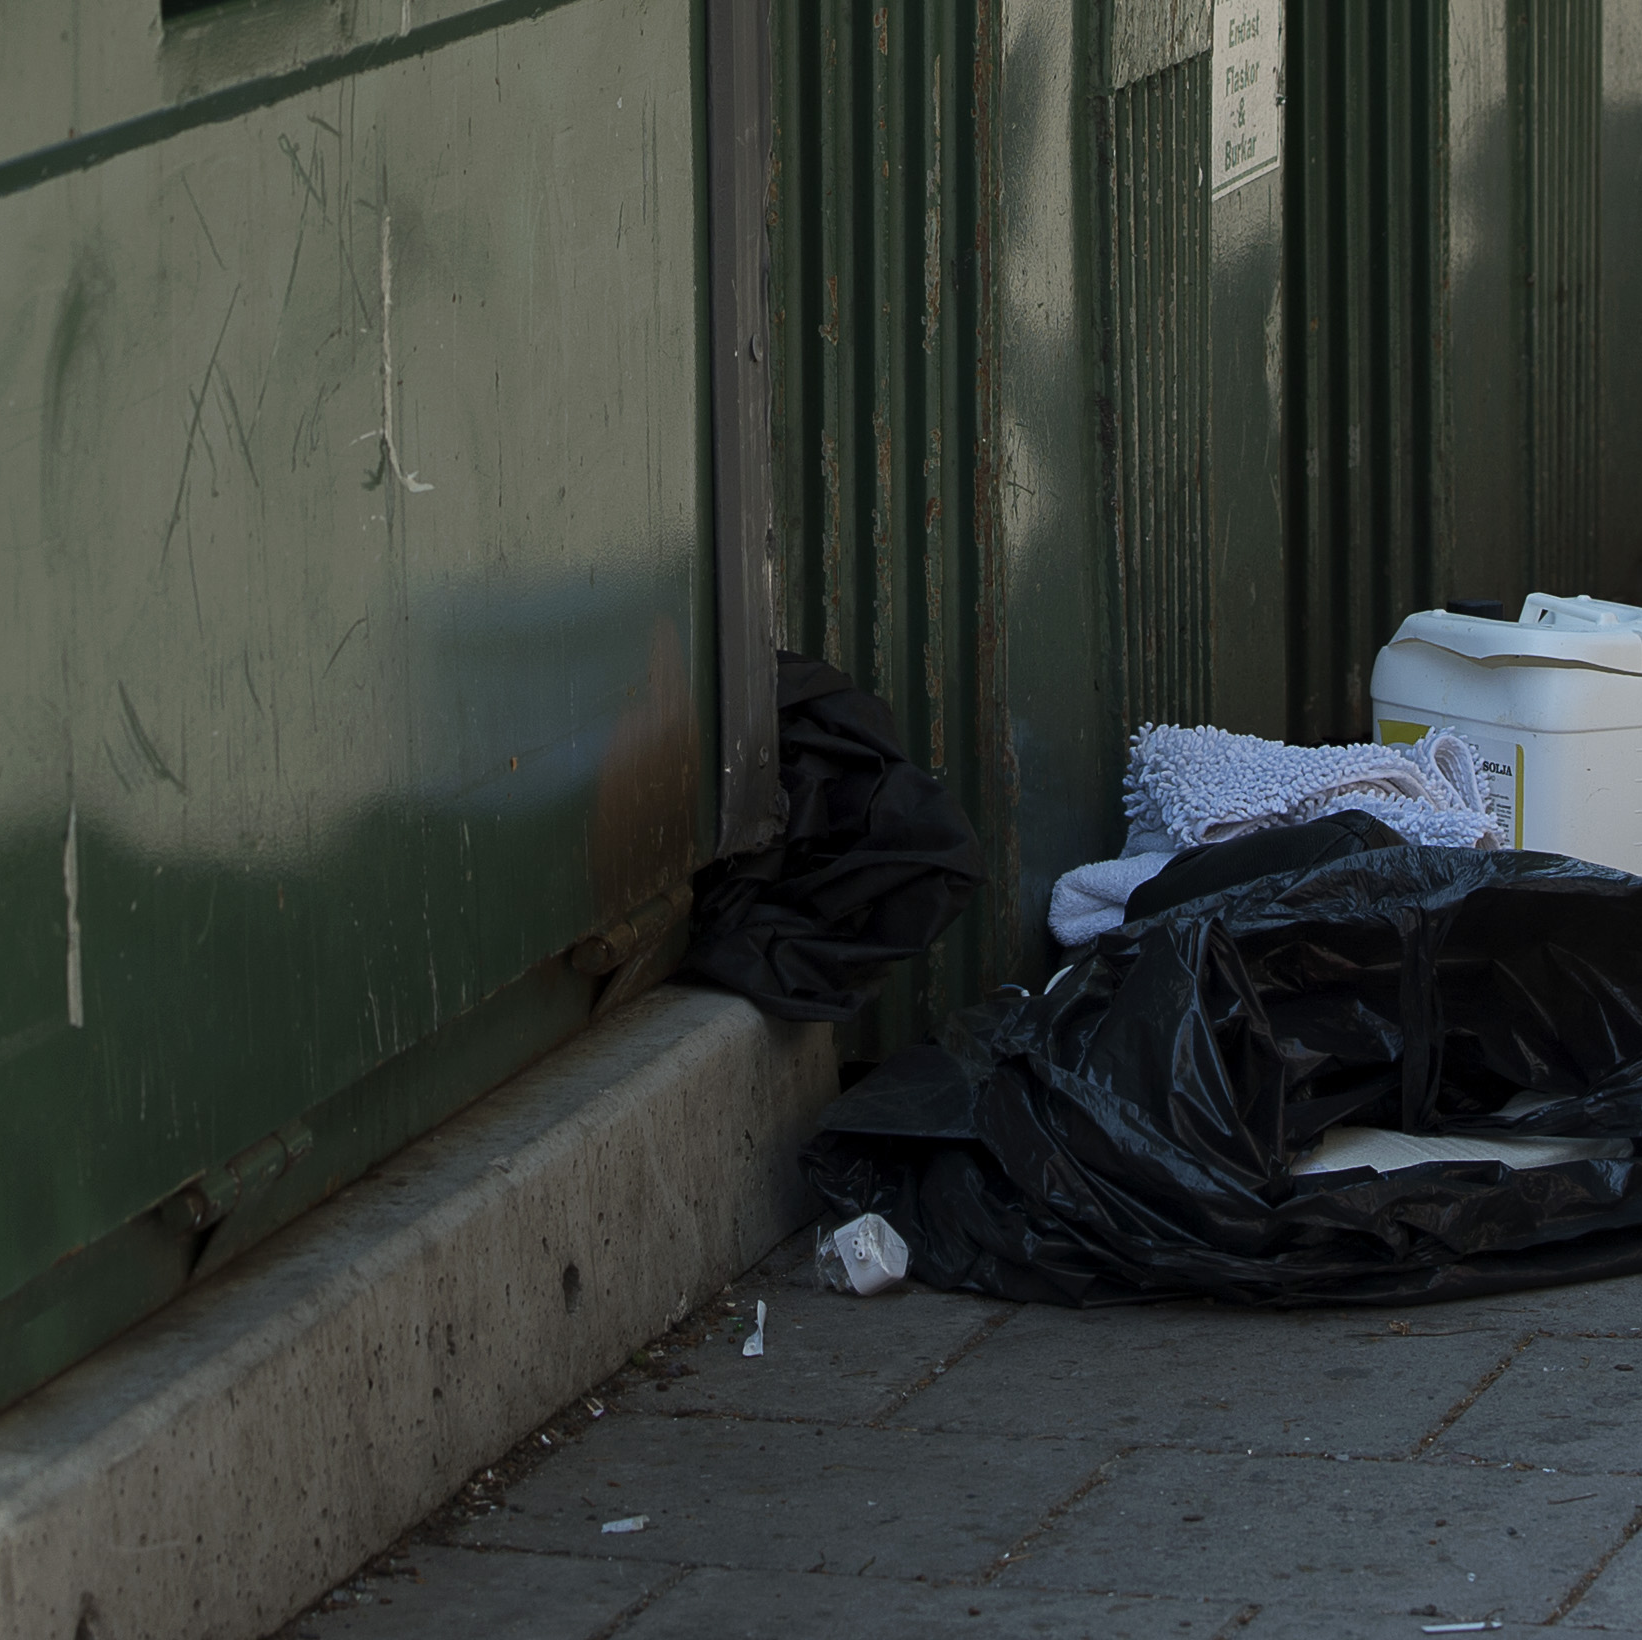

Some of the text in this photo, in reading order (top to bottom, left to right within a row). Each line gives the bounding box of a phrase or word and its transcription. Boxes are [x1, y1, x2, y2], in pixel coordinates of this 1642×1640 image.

[1229, 10, 1260, 49] Endast
[1225, 61, 1260, 97] Flaskor
[1237, 97, 1246, 129] &
[1224, 134, 1257, 173] Burkar
[1482, 760, 1513, 777] SOLJA
